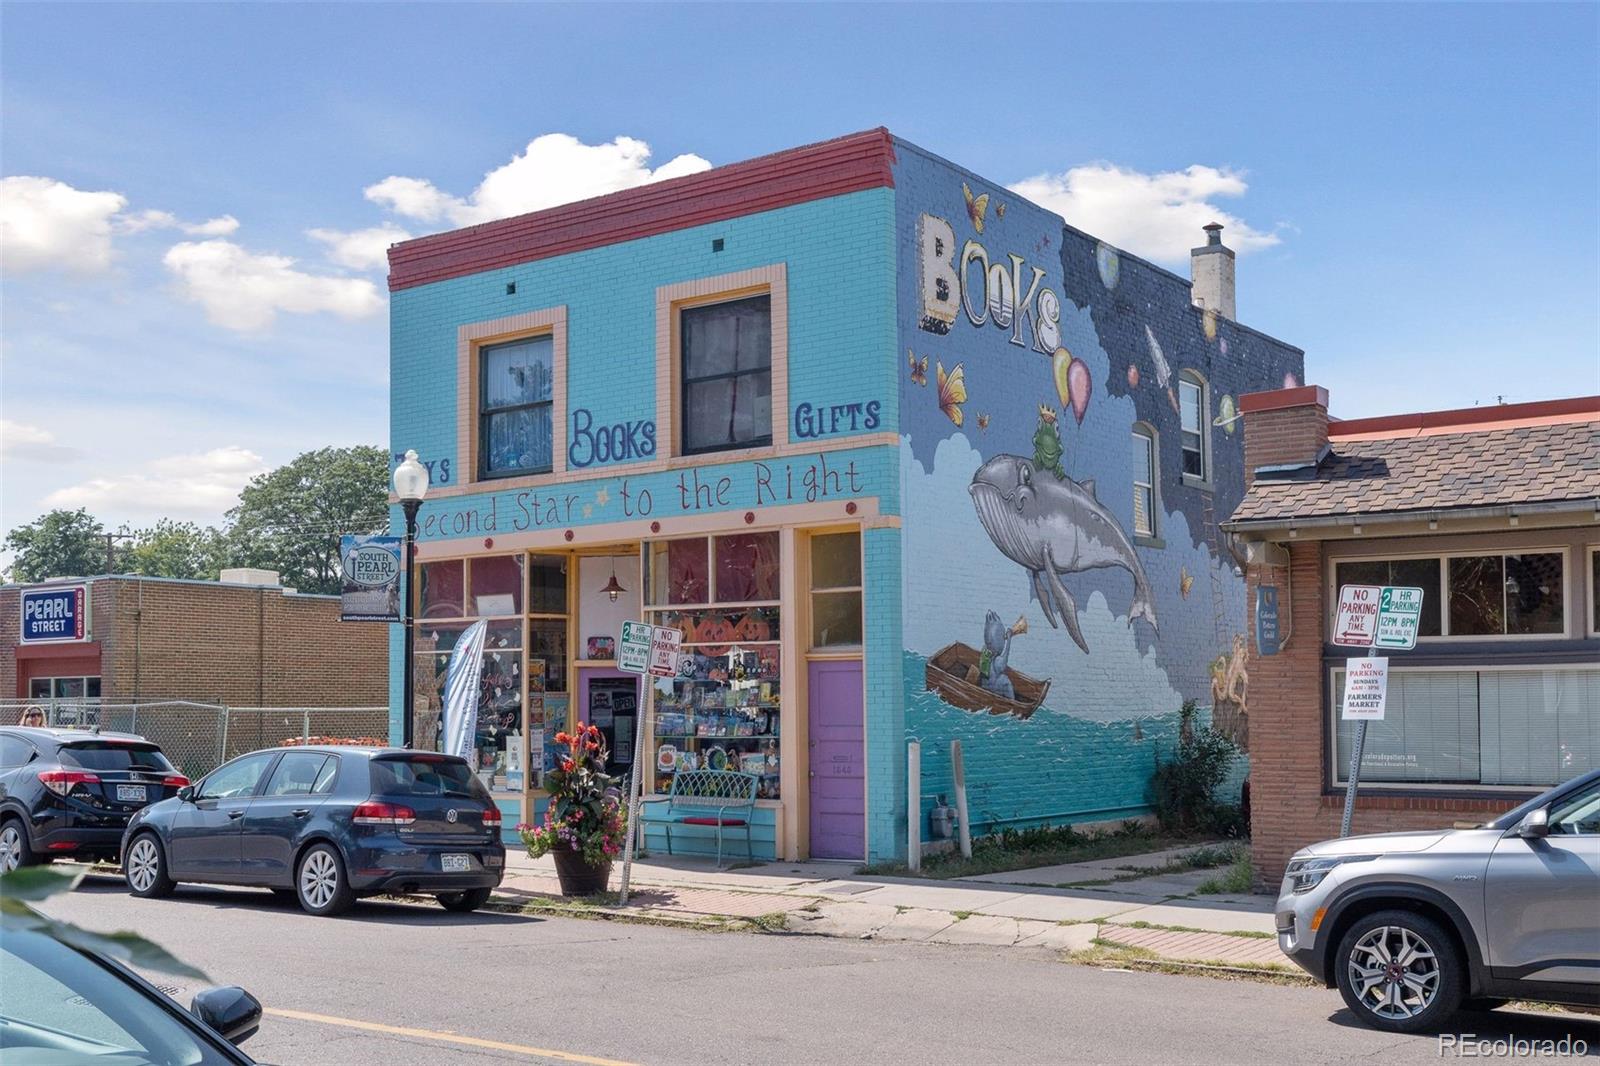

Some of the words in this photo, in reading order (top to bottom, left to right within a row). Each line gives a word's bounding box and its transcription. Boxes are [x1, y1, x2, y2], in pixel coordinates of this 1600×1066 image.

[795, 400, 881, 438] GIFTS
[513, 489, 580, 531] Star
[619, 480, 653, 517] to
[676, 468, 732, 510] the
[753, 454, 864, 506] Right
[359, 552, 389, 562] SOUTH
[357, 561, 395, 577] PEARL
[356, 572, 385, 581] STREET
[1353, 590, 1369, 601] NO
[1382, 591, 1391, 609] 2
[1400, 591, 1412, 600] HR
[25, 597, 73, 620] PEARL
[1341, 602, 1377, 615] PARKING
[1390, 600, 1419, 611] PARKING
[1349, 615, 1365, 623] ANY
[1380, 616, 1398, 627] 12PM
[1400, 617, 1416, 627] 8PM
[31, 620, 66, 633] STREET
[636, 626, 646, 634] HR
[1348, 622, 1365, 631] TIME
[623, 625, 630, 640] 2
[630, 633, 650, 643] PARKING
[661, 630, 673, 641] NO
[653, 640, 678, 653] PARKING
[657, 657, 670, 666] TIME
